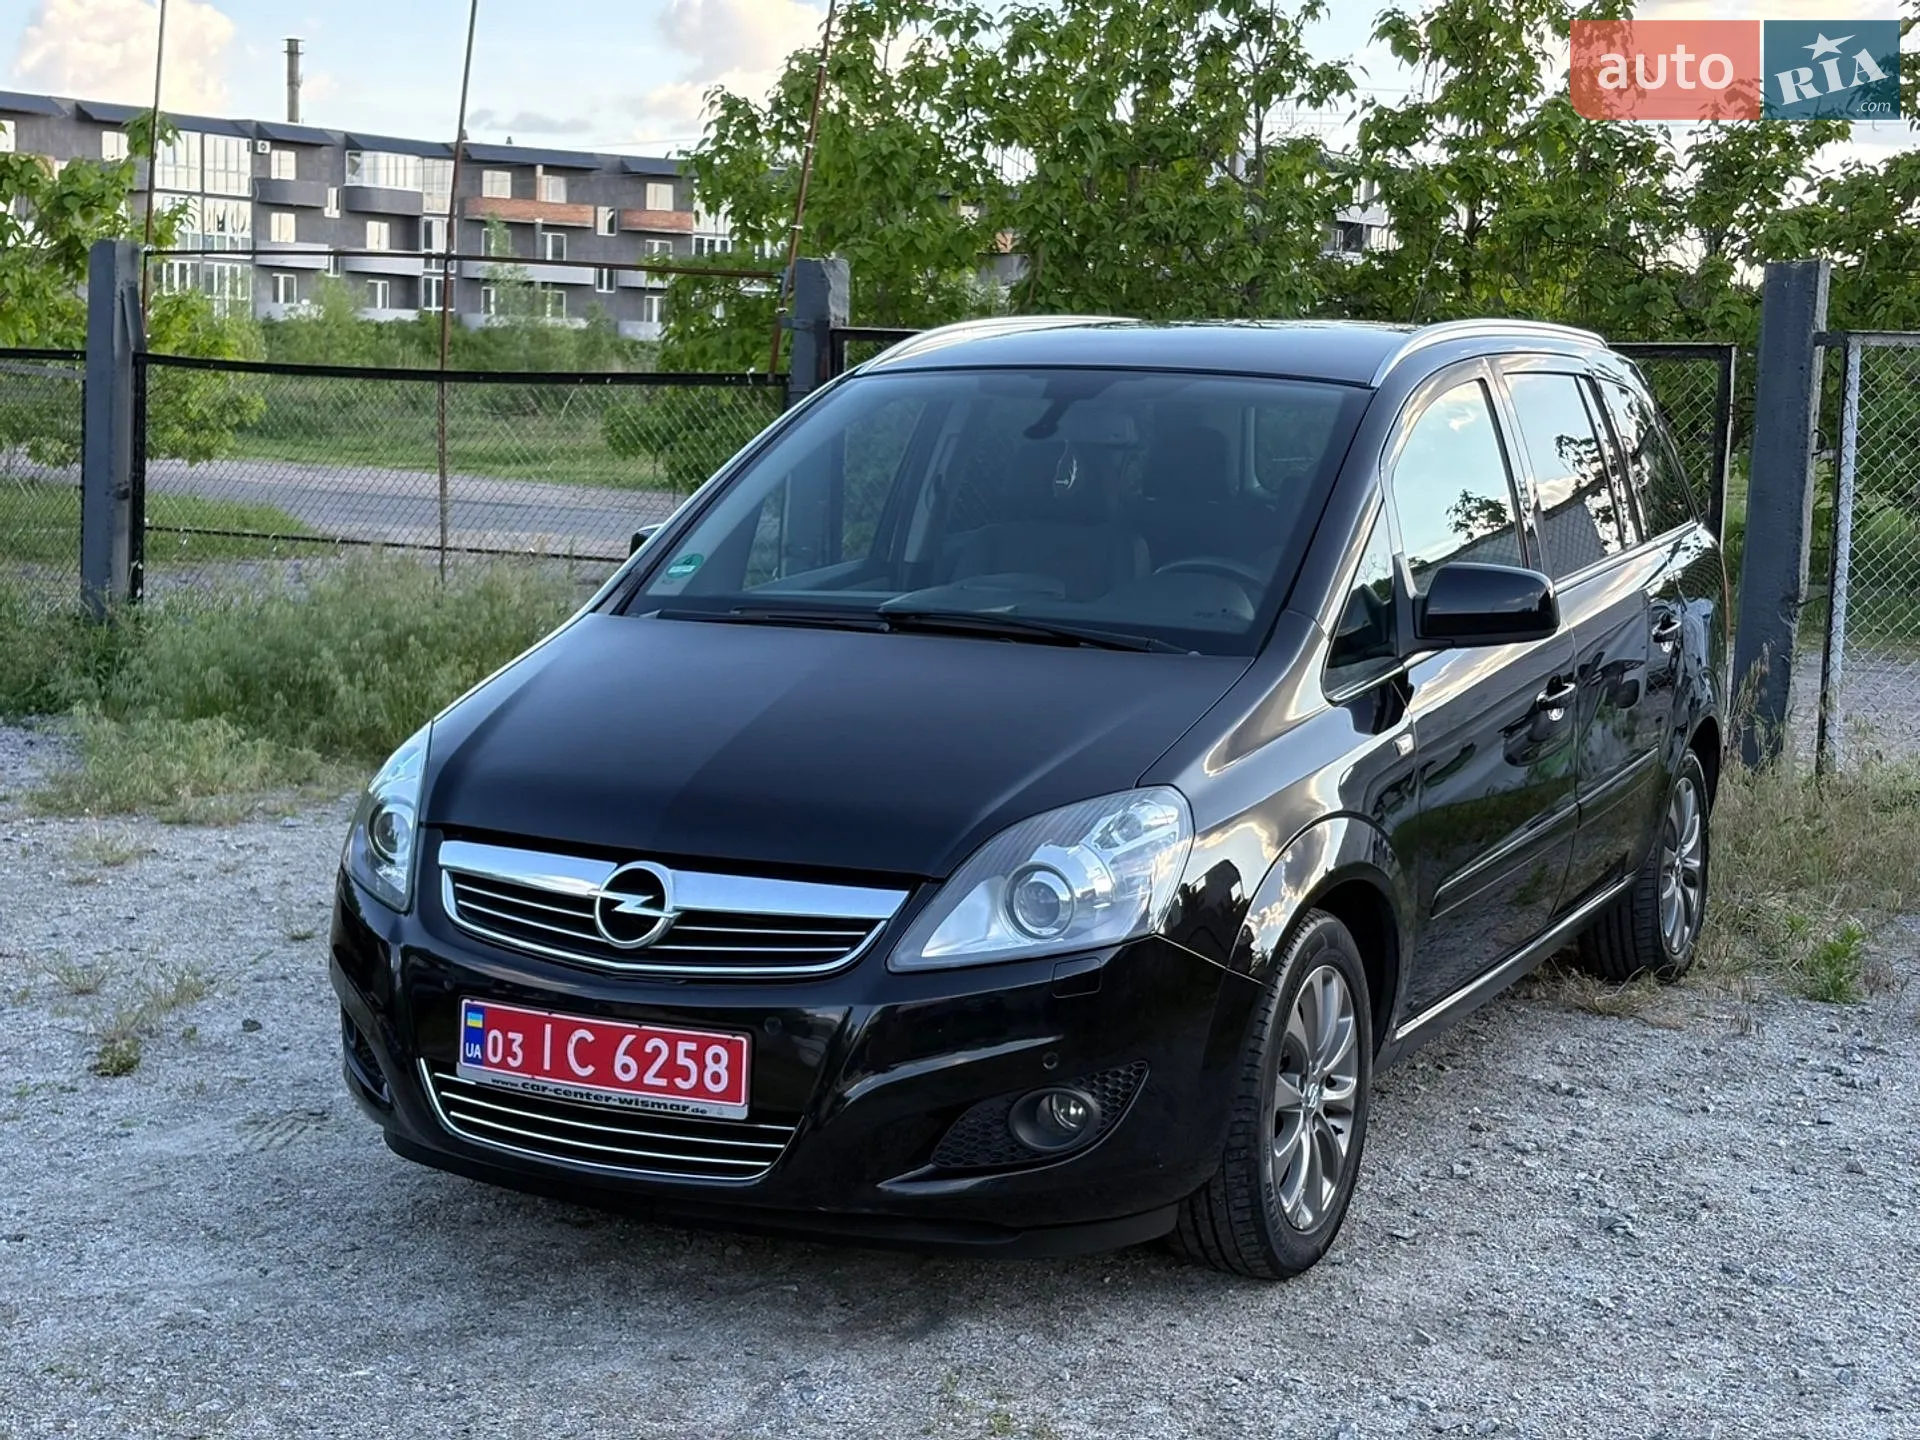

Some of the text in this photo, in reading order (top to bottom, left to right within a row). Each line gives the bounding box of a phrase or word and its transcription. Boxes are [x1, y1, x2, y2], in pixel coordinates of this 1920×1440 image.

[465, 1041, 483, 1060] UA
[486, 1023, 729, 1093] 03 IC 6258
[491, 1077, 708, 1115] www.car-center-wismar.de
